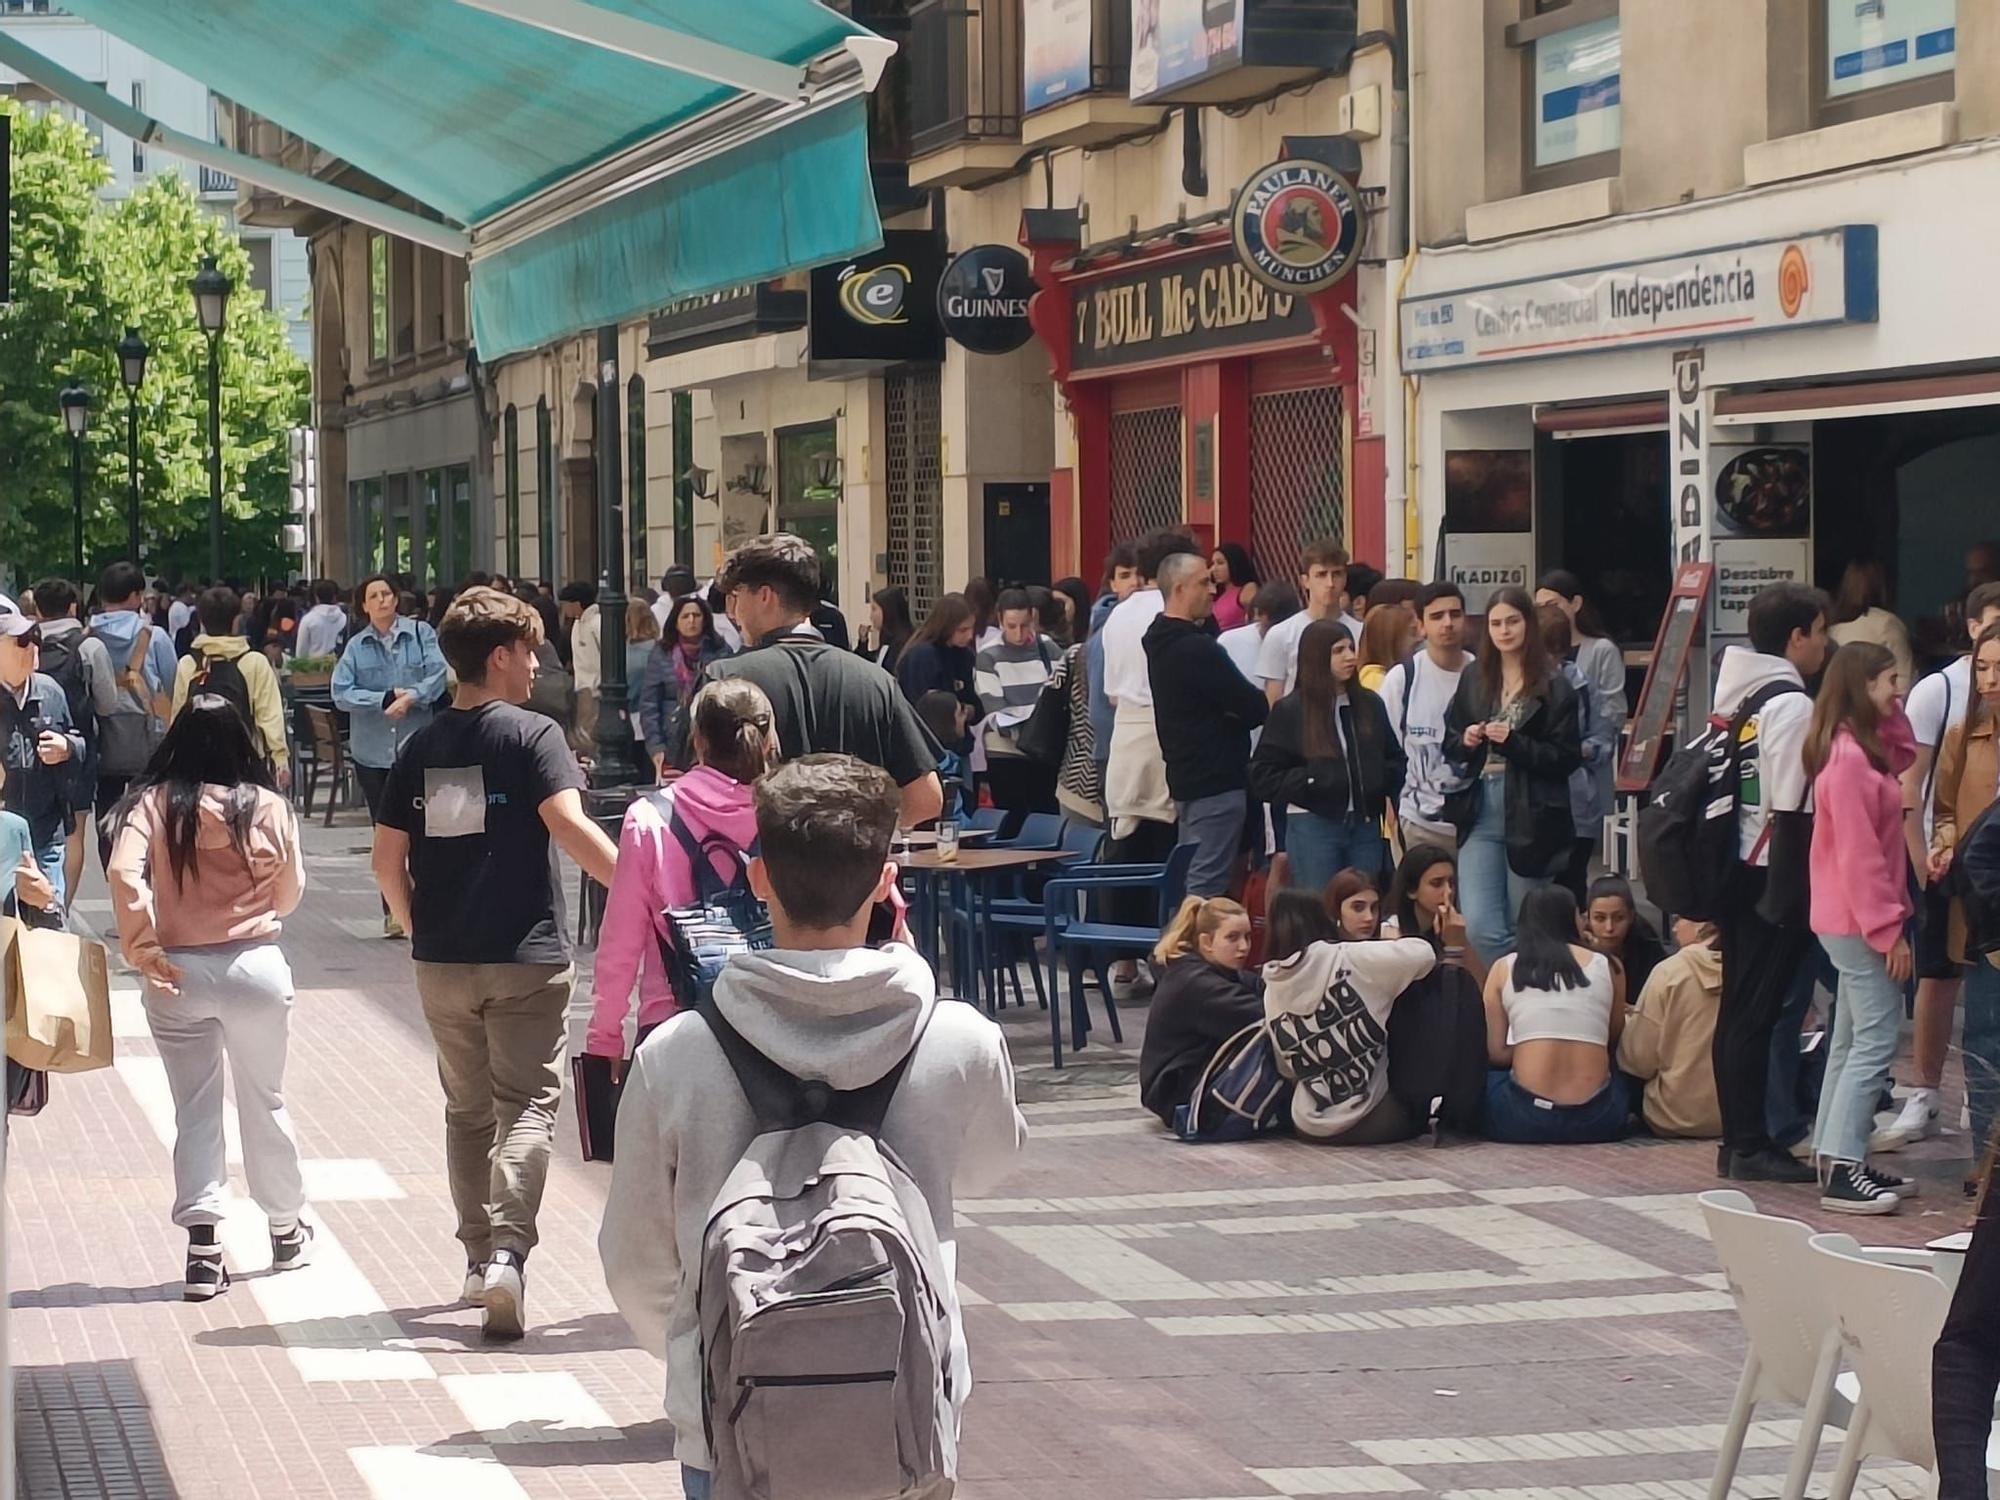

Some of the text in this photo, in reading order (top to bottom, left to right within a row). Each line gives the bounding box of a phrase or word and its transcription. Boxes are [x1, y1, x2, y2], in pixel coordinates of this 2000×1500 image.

[1247, 168, 1352, 216] PAULANER
[948, 296, 1028, 317] GUINNES
[1094, 282, 1153, 350] BULL
[1525, 291, 1599, 331] Comercial
[1610, 258, 1755, 324] Independencia
